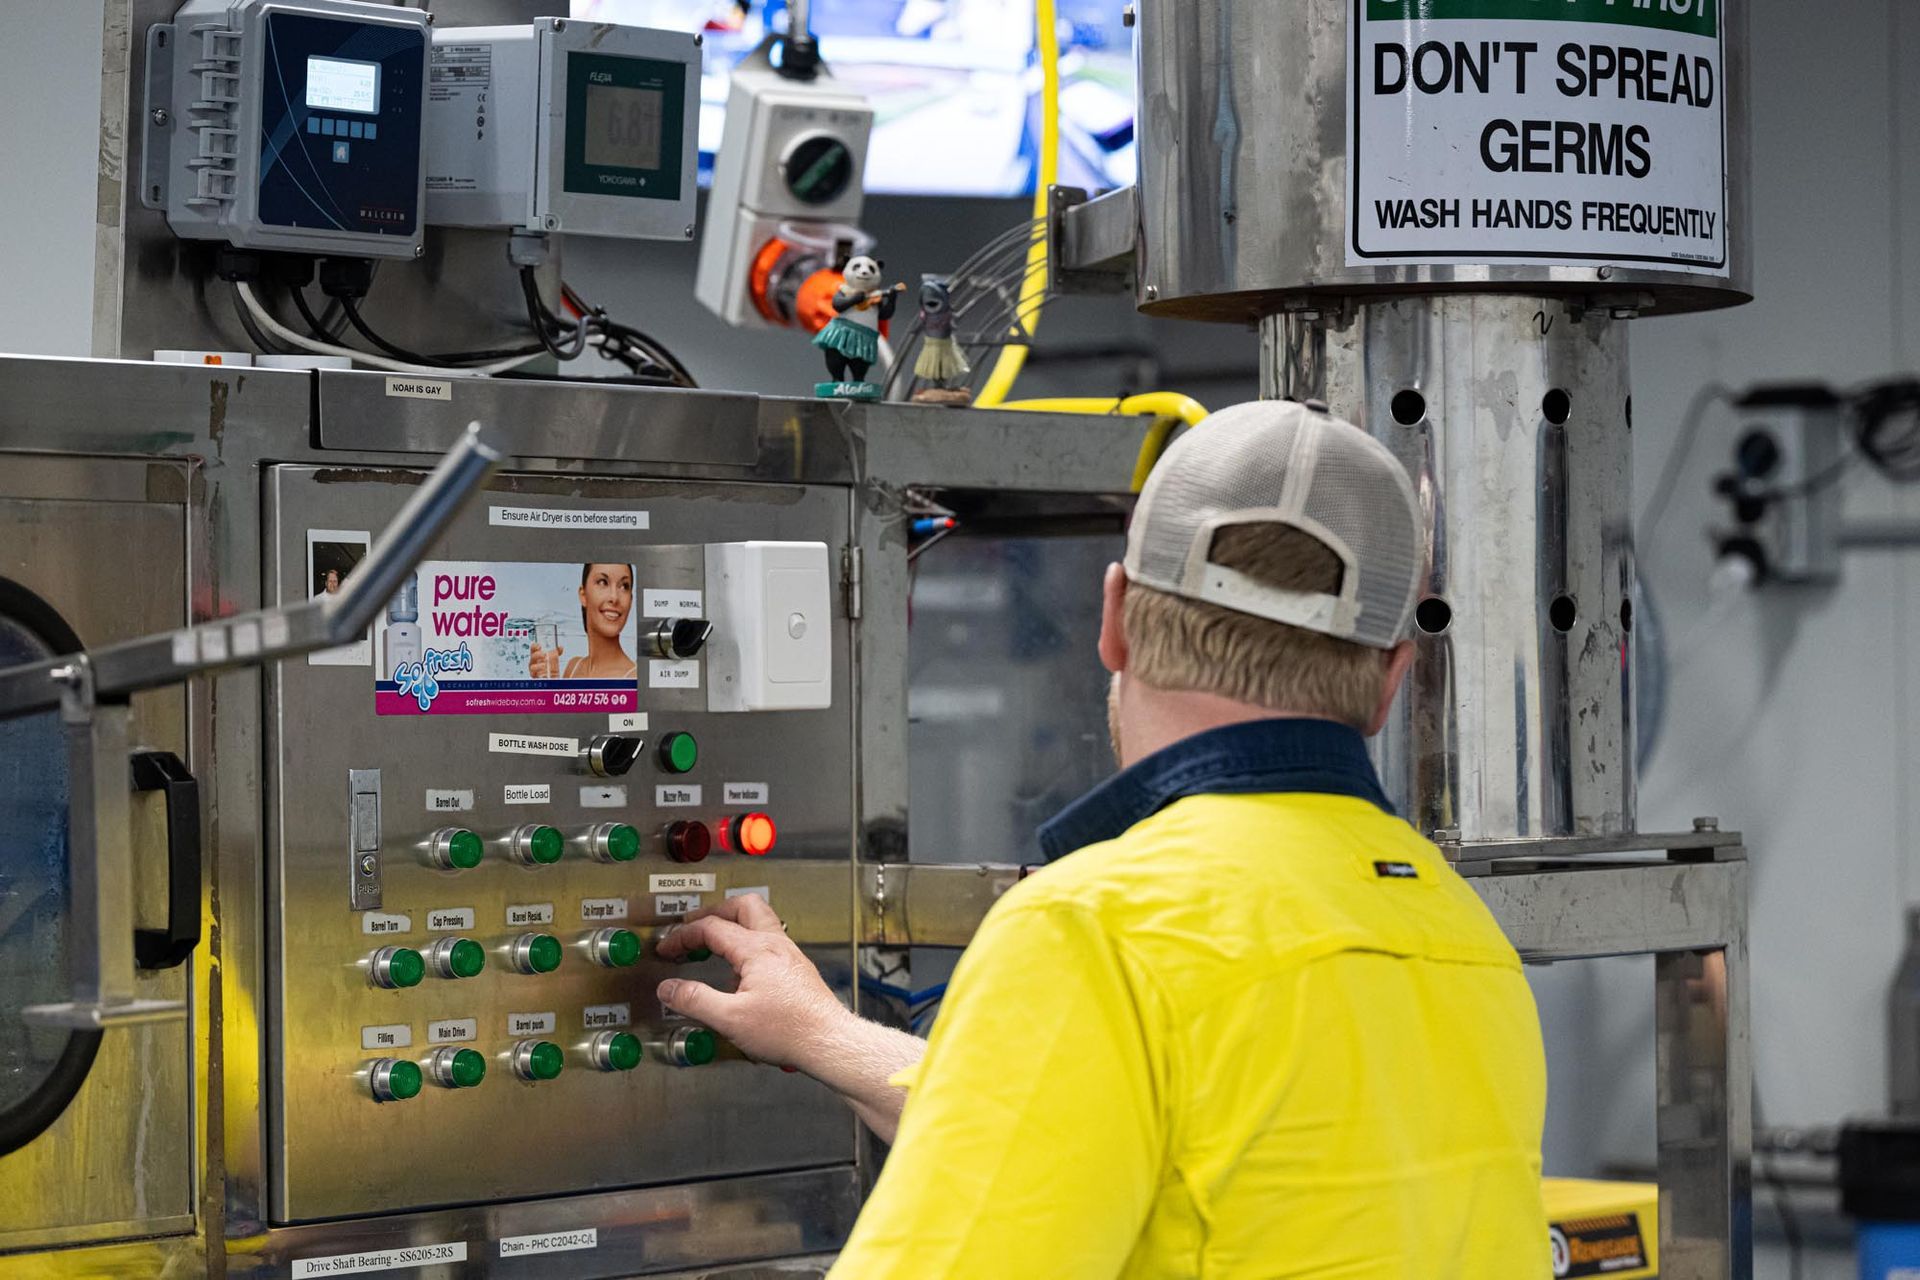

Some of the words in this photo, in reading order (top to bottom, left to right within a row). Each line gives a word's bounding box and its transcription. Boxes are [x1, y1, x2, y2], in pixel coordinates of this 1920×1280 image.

[1374, 41, 1538, 95] DON'T
[1556, 43, 1714, 108] SPREAD
[1480, 118, 1651, 178] GERMS
[1375, 199, 1460, 229] WASH
[1472, 199, 1572, 231] HANDS
[1582, 202, 1717, 240] FREQUENTLY
[392, 383, 415, 393] NOAH
[416, 385, 424, 394] IS
[425, 386, 442, 395] GAY
[502, 509, 529, 521] Ensure
[530, 511, 541, 522] Air
[542, 511, 563, 525] Dryer
[564, 513, 571, 523] is
[572, 515, 583, 524] on
[583, 513, 608, 524] before
[609, 515, 637, 526] starting
[433, 574, 496, 607] pure
[432, 604, 528, 638] water...
[423, 641, 473, 676] fresh
[660, 670, 671, 678] AIR
[465, 697, 546, 707] sofreshwidebay.com.au
[553, 693, 576, 706] 0428
[578, 693, 593, 705] 747
[594, 693, 608, 705] 576
[623, 719, 634, 727] ON
[498, 738, 527, 749] BOTTLE
[528, 741, 548, 750] WASH
[549, 742, 569, 751] DOSE
[506, 789, 529, 800] Bottle
[530, 788, 549, 799] Load
[436, 797, 450, 808] Barrel
[658, 879, 686, 887] REDUCE
[689, 879, 703, 887] FILL
[433, 916, 442, 928] Cap
[443, 914, 464, 927] Pressing
[512, 911, 526, 923] Barrel
[371, 920, 386, 932] Barrel
[516, 1019, 531, 1031] Barrel
[438, 1027, 452, 1038] Main
[453, 1026, 467, 1037] Drive
[378, 1033, 395, 1045] Filling
[501, 1242, 525, 1253] Chain
[531, 1238, 550, 1249] PHC
[550, 1233, 595, 1248] C2042-C/L
[306, 1260, 331, 1273] Drive
[332, 1257, 356, 1270] Shaft
[358, 1253, 392, 1269] Bearing
[399, 1247, 454, 1264] SS6205-2RS
